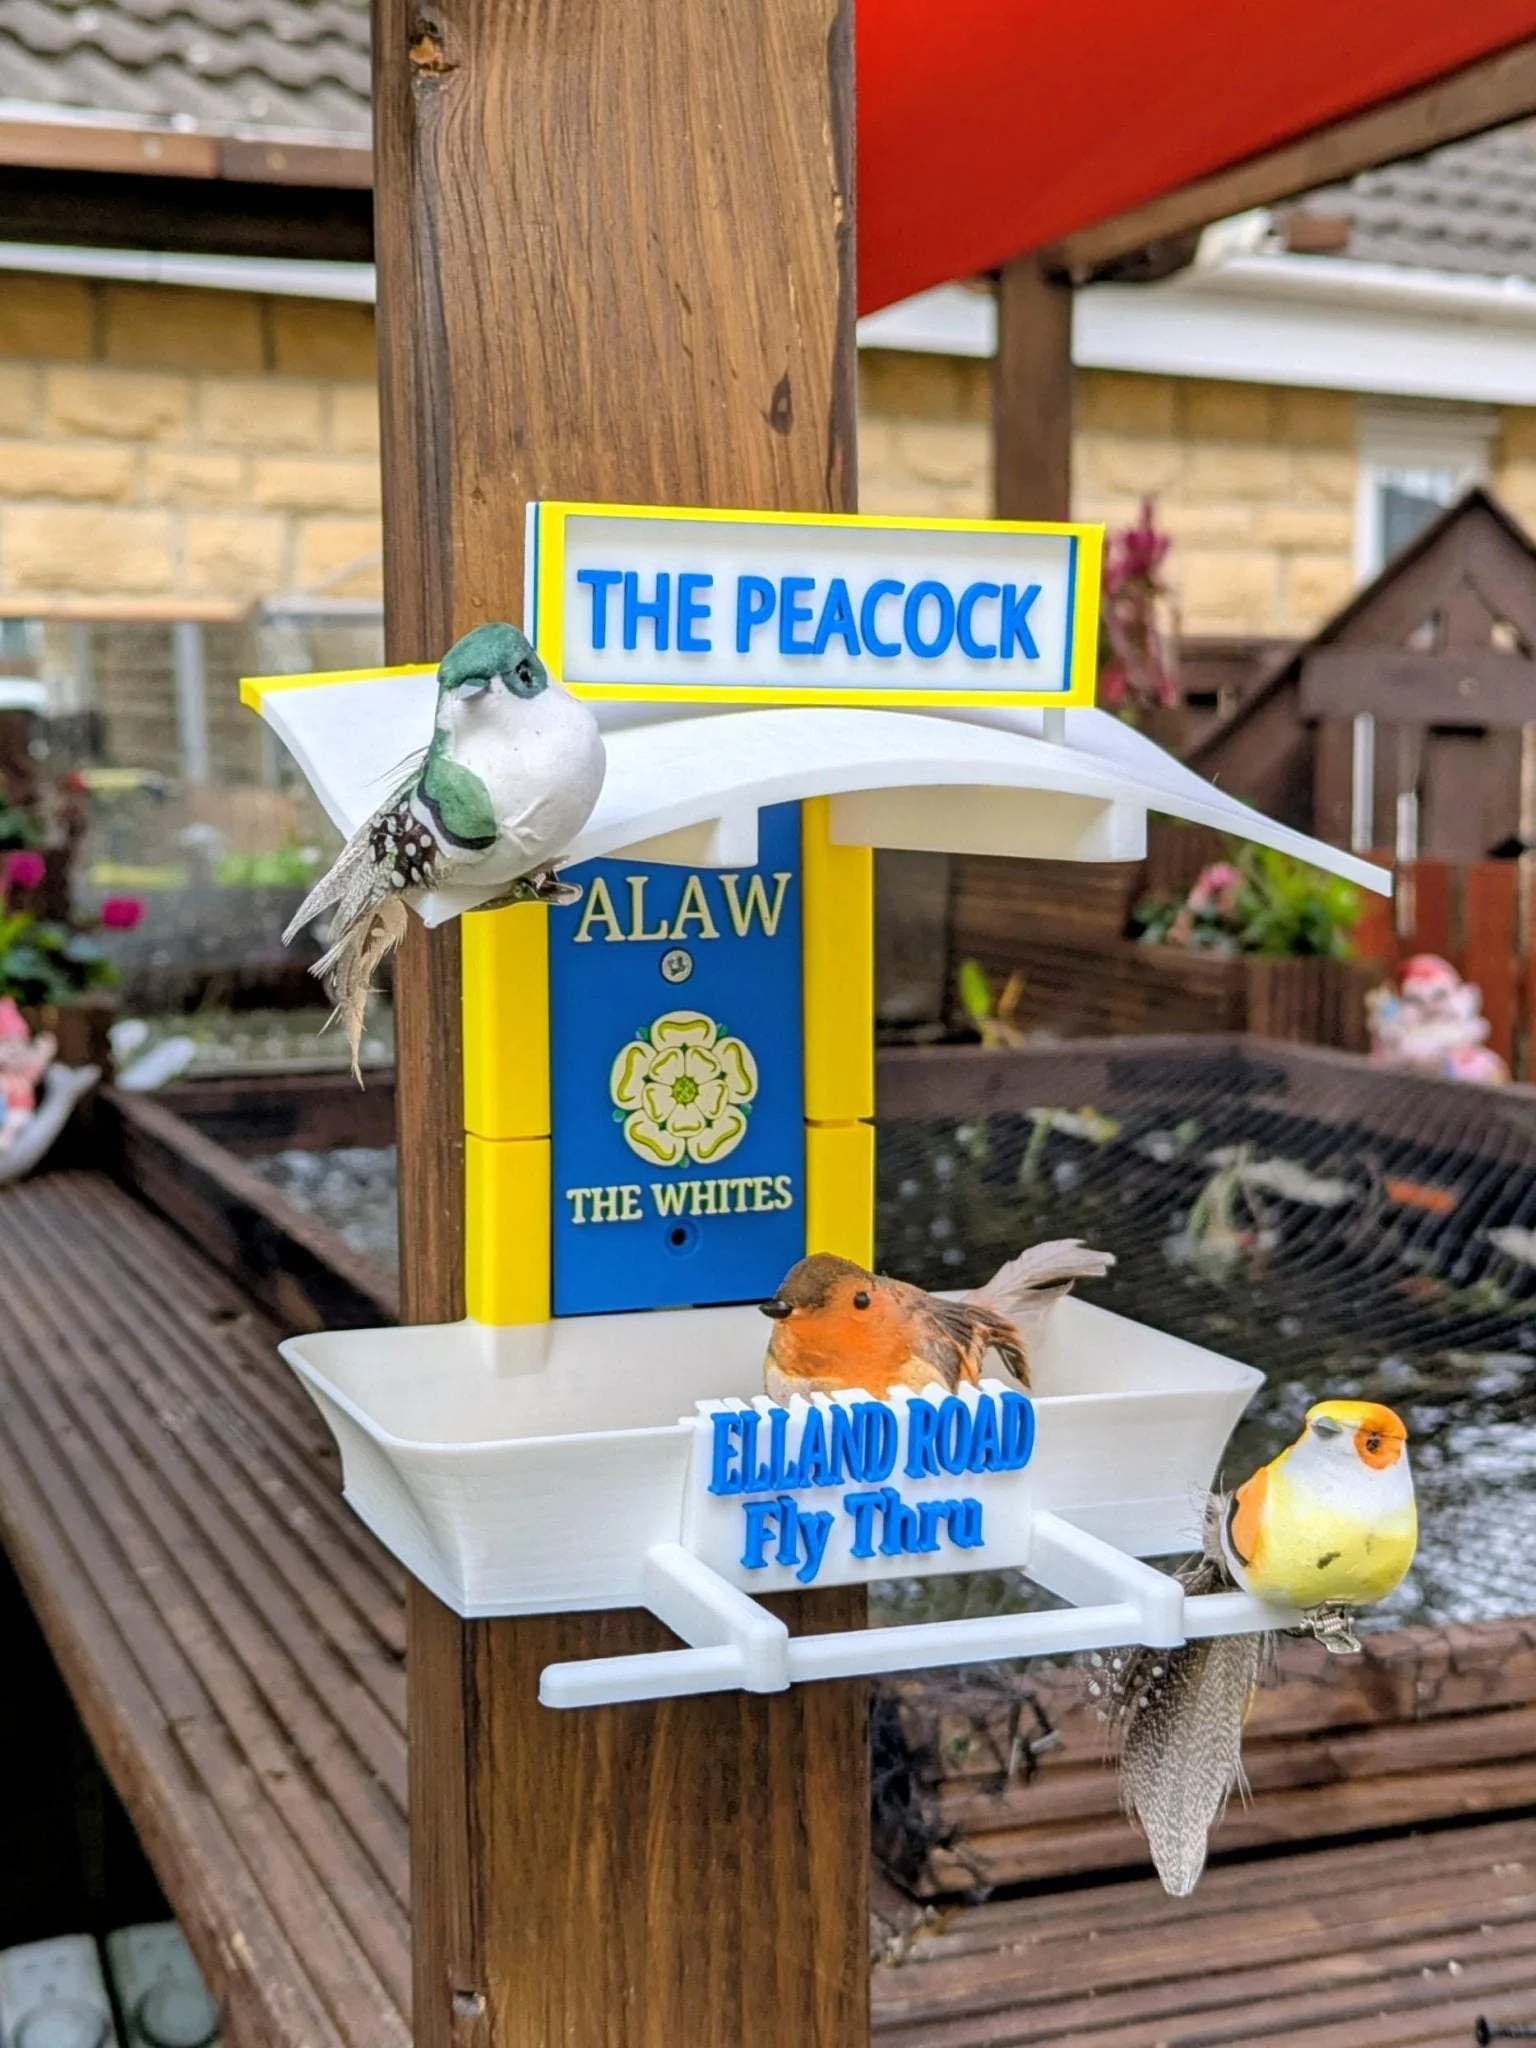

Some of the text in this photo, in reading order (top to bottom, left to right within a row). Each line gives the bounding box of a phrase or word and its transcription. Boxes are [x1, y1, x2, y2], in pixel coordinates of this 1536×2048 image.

[577, 569, 1042, 660] THE PEACOCK
[574, 872, 792, 943] ALAW
[566, 1176, 793, 1224] THE WHITES
[708, 1391, 1036, 1495] ELLAND ROAD
[740, 1487, 984, 1583] Fly Thru
